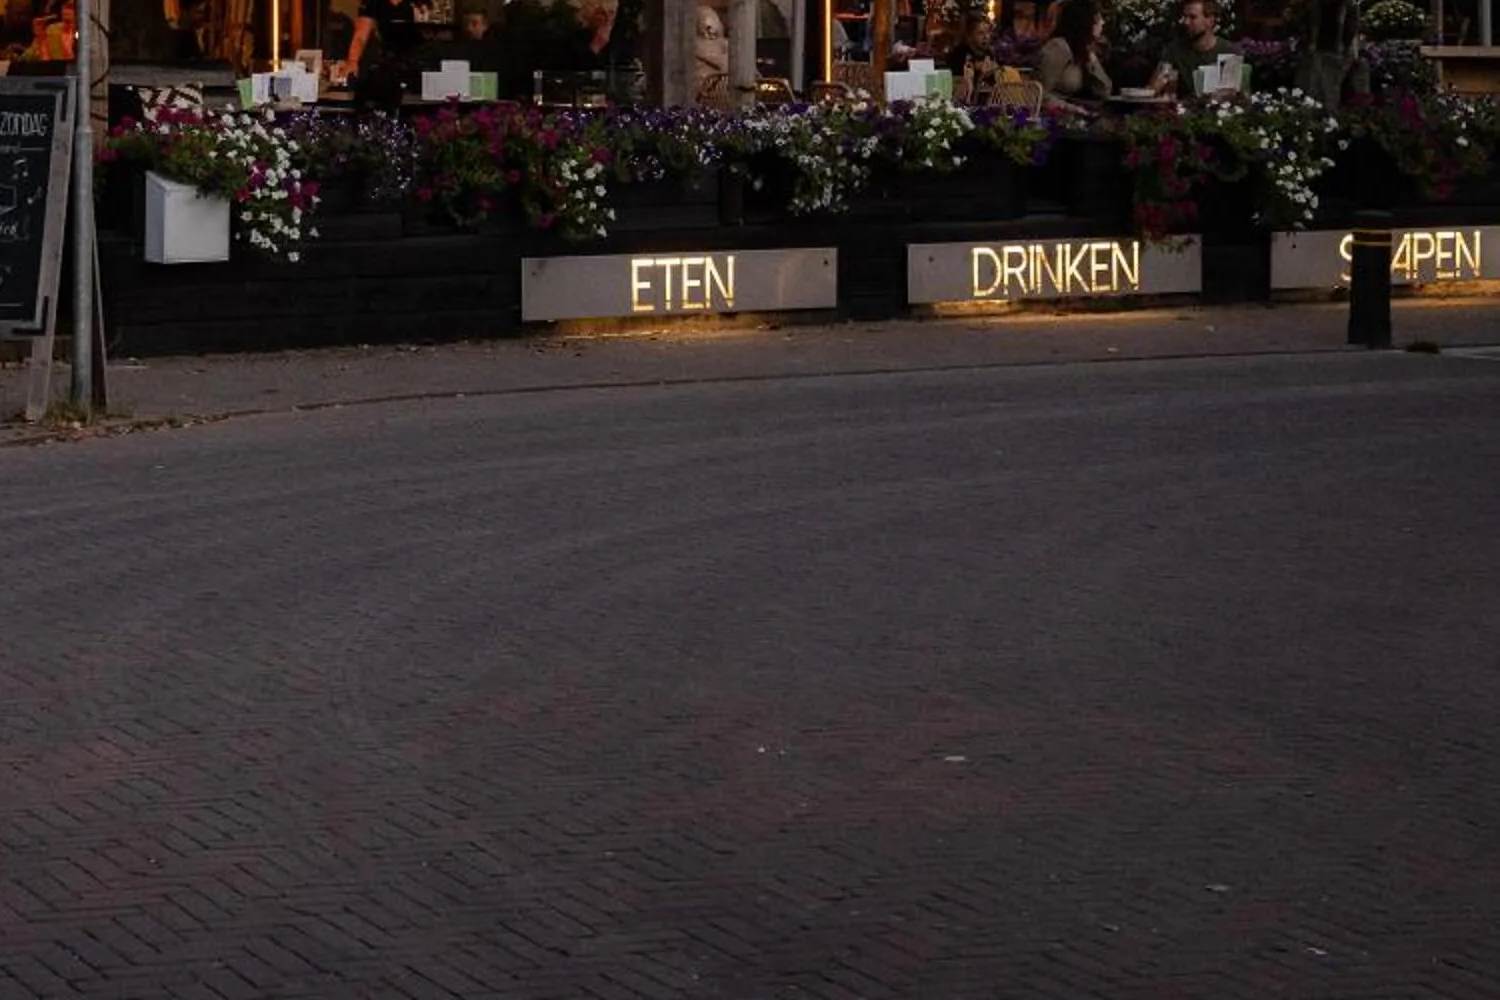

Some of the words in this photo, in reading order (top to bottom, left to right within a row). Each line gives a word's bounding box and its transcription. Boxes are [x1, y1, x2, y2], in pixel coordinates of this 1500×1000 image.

[973, 241, 1139, 297] DRINKEN
[1339, 230, 1481, 281] SAPEN
[631, 256, 734, 311] ETEN
